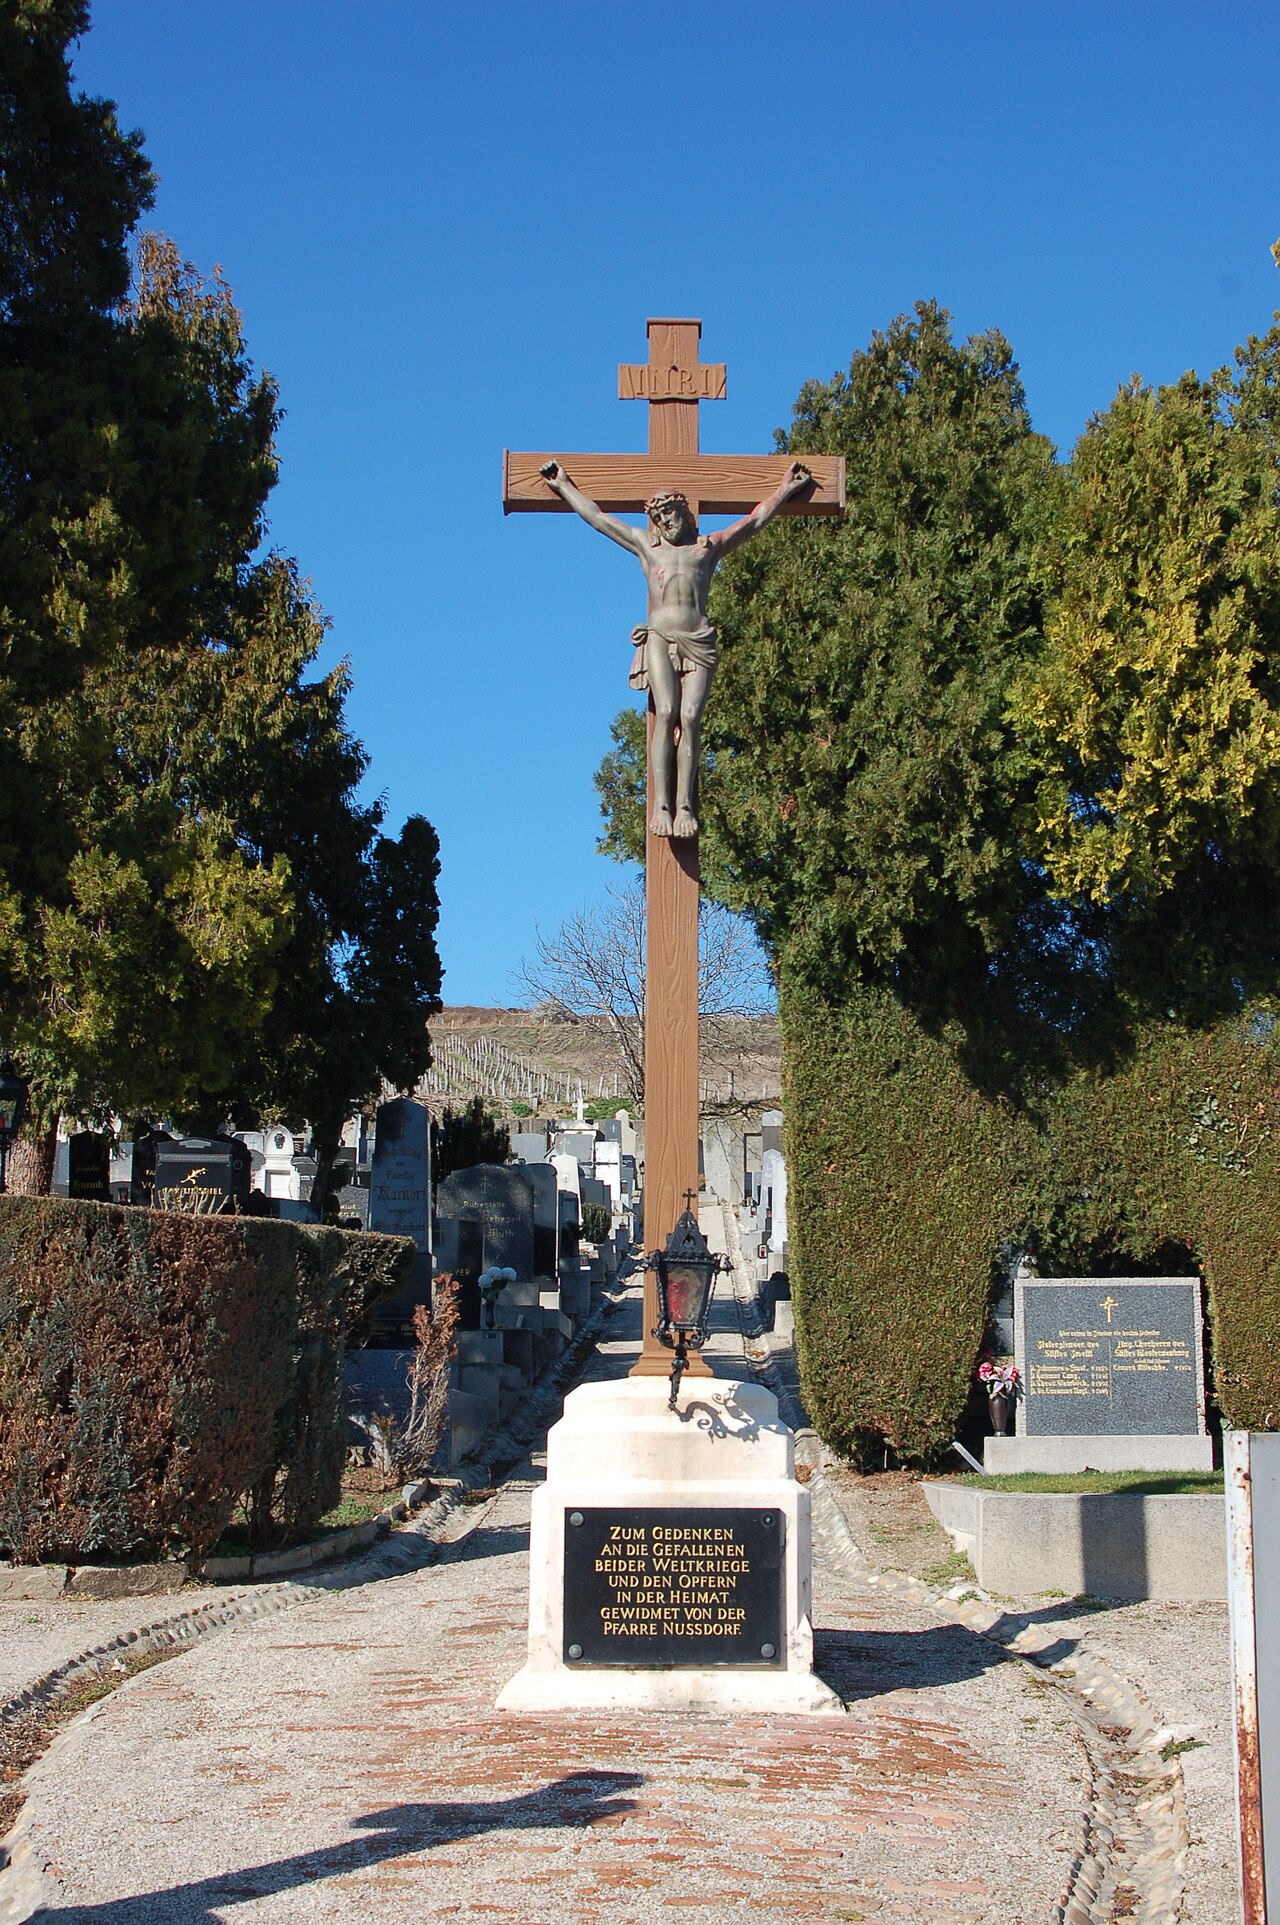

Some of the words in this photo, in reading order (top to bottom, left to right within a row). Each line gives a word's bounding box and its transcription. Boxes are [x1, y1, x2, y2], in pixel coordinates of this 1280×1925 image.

[610, 1527, 645, 1540] ZUM
[652, 1527, 733, 1540] GEDENKEN
[601, 1544, 621, 1556] AN
[627, 1544, 648, 1556] DIE
[653, 1543, 745, 1556] GEFALLENEN
[595, 1560, 646, 1572] BEIDER
[653, 1559, 750, 1572] WELTKRIEGE
[609, 1575, 638, 1587] UND
[643, 1576, 672, 1587] DEN
[679, 1575, 736, 1588] OPFERN
[617, 1592, 631, 1603] IN
[636, 1592, 665, 1603] DER
[670, 1591, 729, 1604] HEIMAT
[600, 1607, 680, 1620] GEWIDMET
[684, 1608, 712, 1620] VON
[718, 1608, 745, 1620] DER
[604, 1623, 657, 1635] PFARRE
